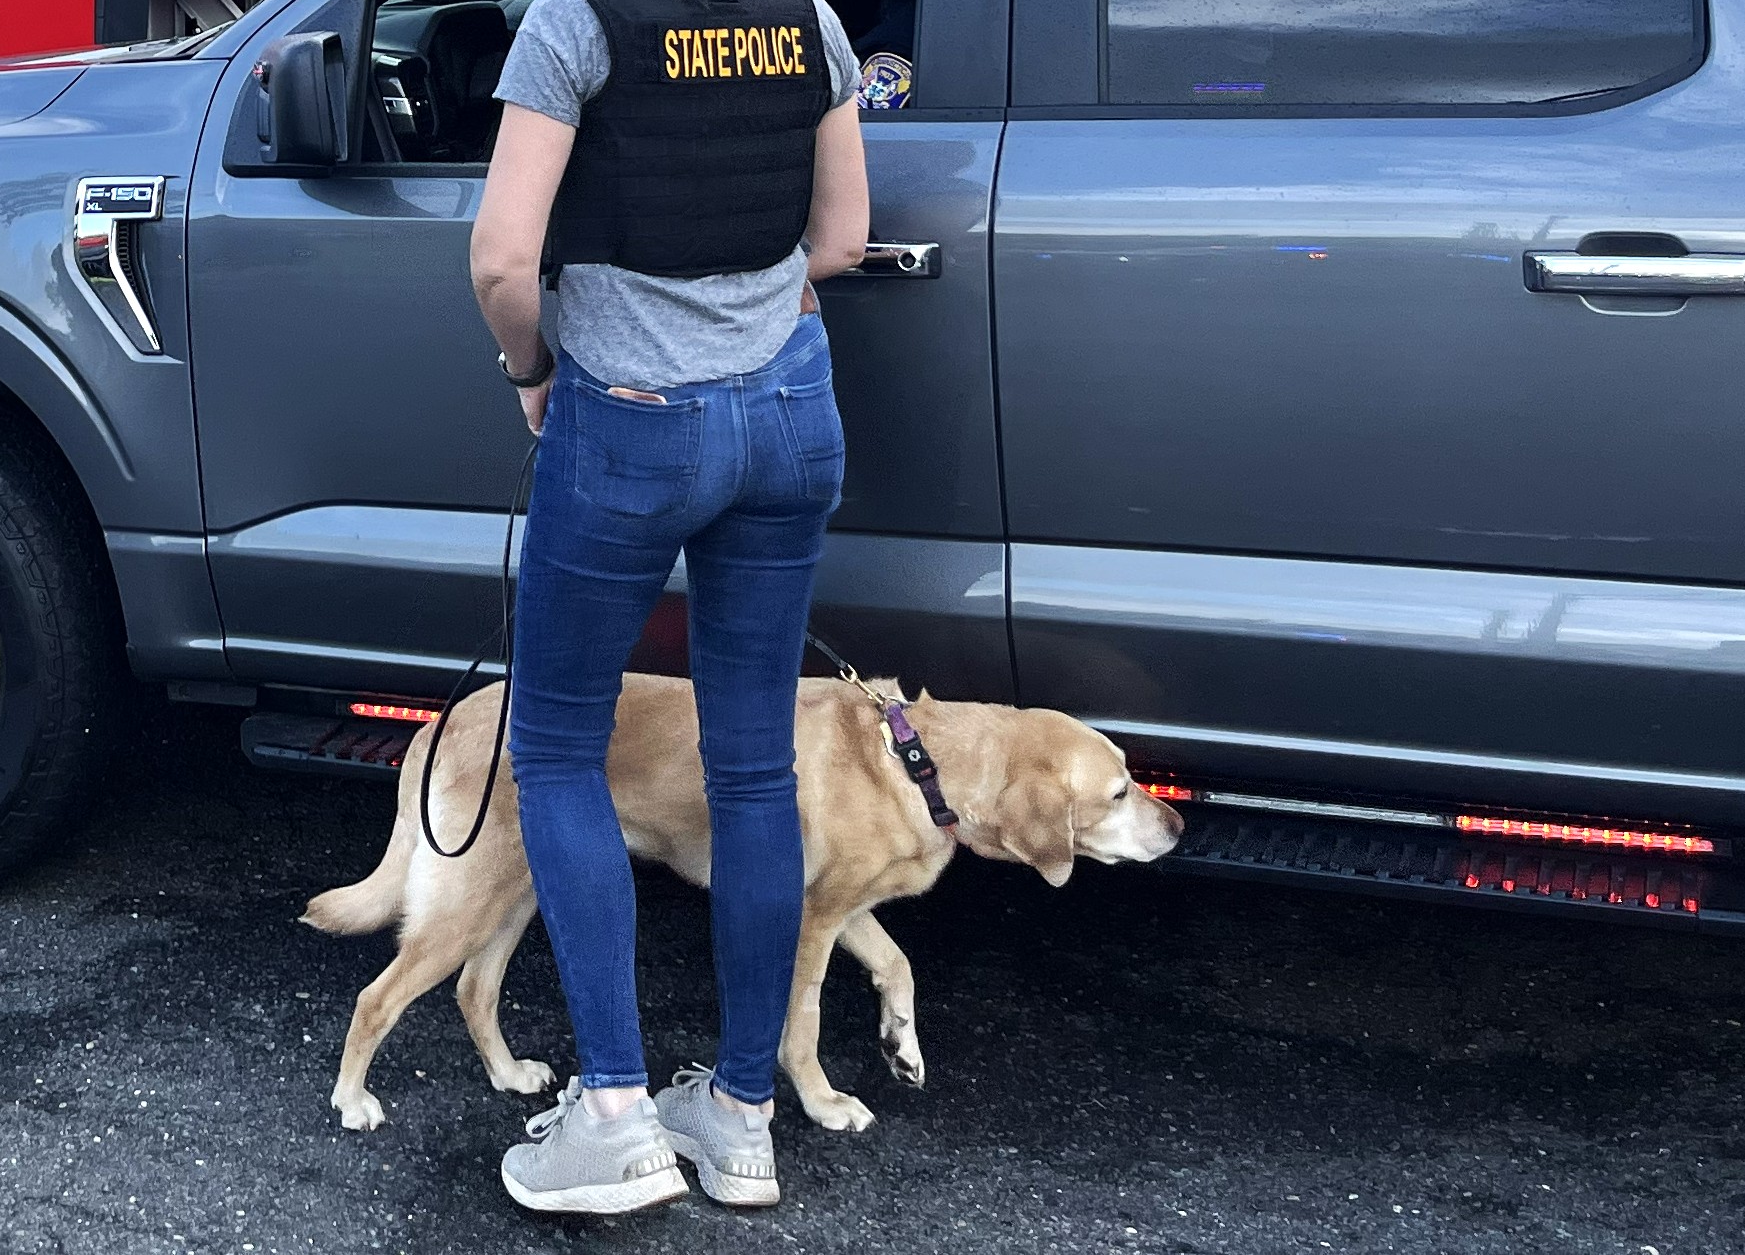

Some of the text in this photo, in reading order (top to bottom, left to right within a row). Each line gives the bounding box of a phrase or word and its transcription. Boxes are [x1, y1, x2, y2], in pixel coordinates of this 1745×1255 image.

[664, 26, 806, 79] STATE POLICE
[85, 187, 152, 201] F-150
[86, 202, 103, 211] XL
